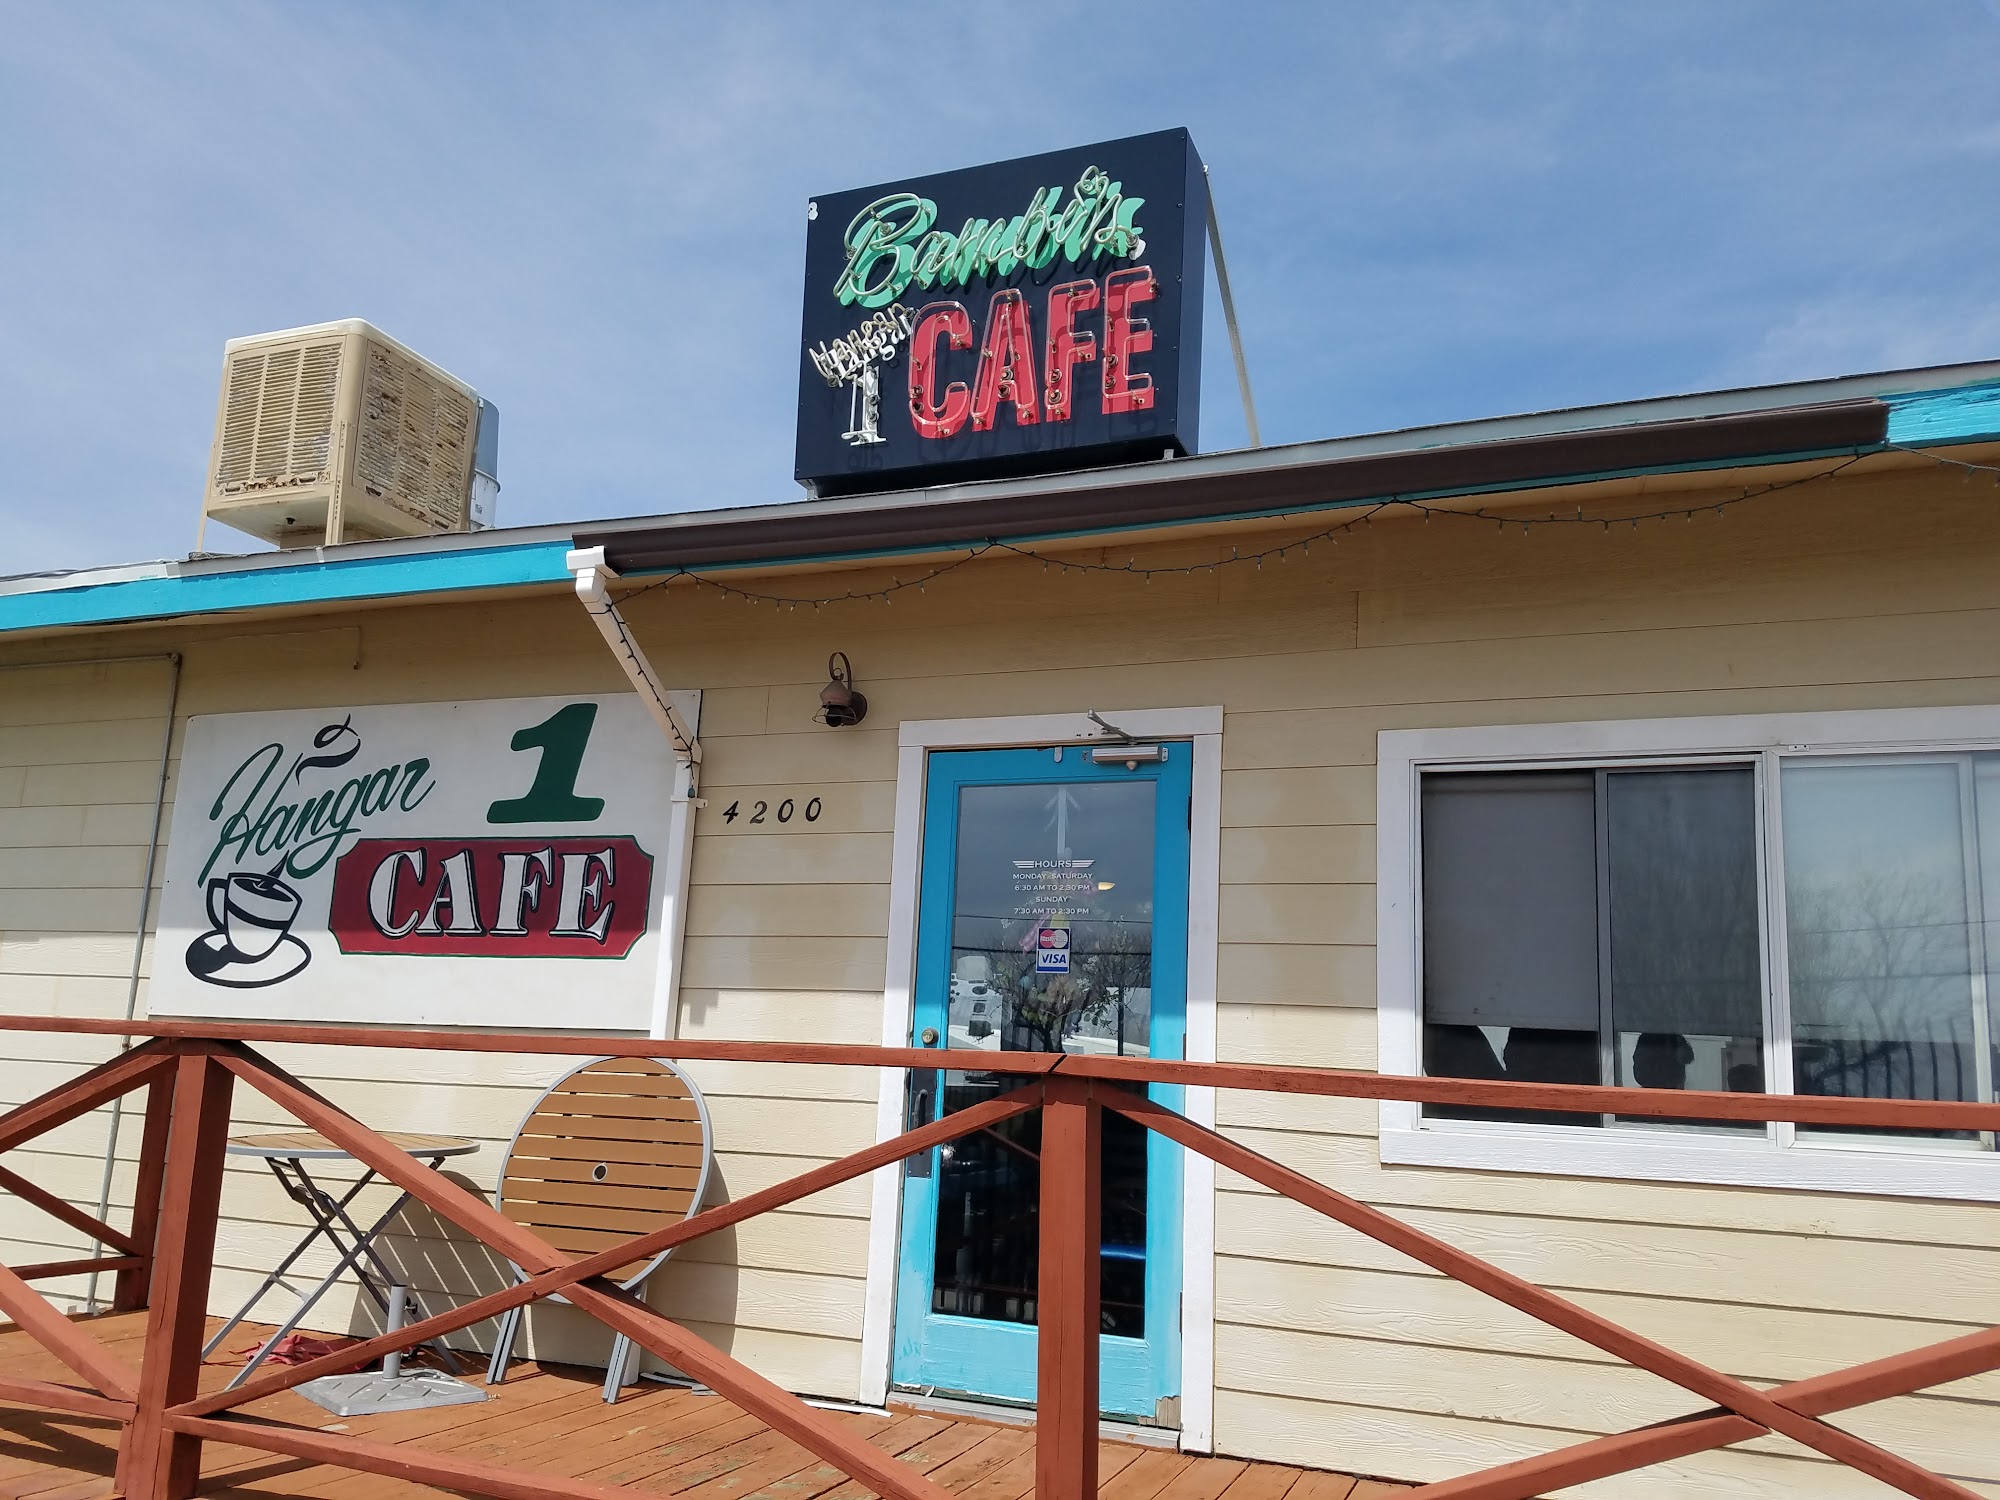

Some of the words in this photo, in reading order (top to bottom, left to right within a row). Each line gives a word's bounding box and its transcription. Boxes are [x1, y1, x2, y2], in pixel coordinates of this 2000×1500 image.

[908, 264, 1157, 440] CAFE
[197, 742, 436, 887] Hangar
[486, 702, 606, 824] 1
[722, 797, 822, 825] 4200
[1034, 860, 1072, 868] HOURS
[366, 844, 616, 945] CAFE
[1032, 907, 1046, 915] AM
[1046, 907, 1057, 915] TO
[1058, 907, 1076, 915] 2:30
[1076, 907, 1089, 915] PM
[1042, 953, 1067, 964] VISA
